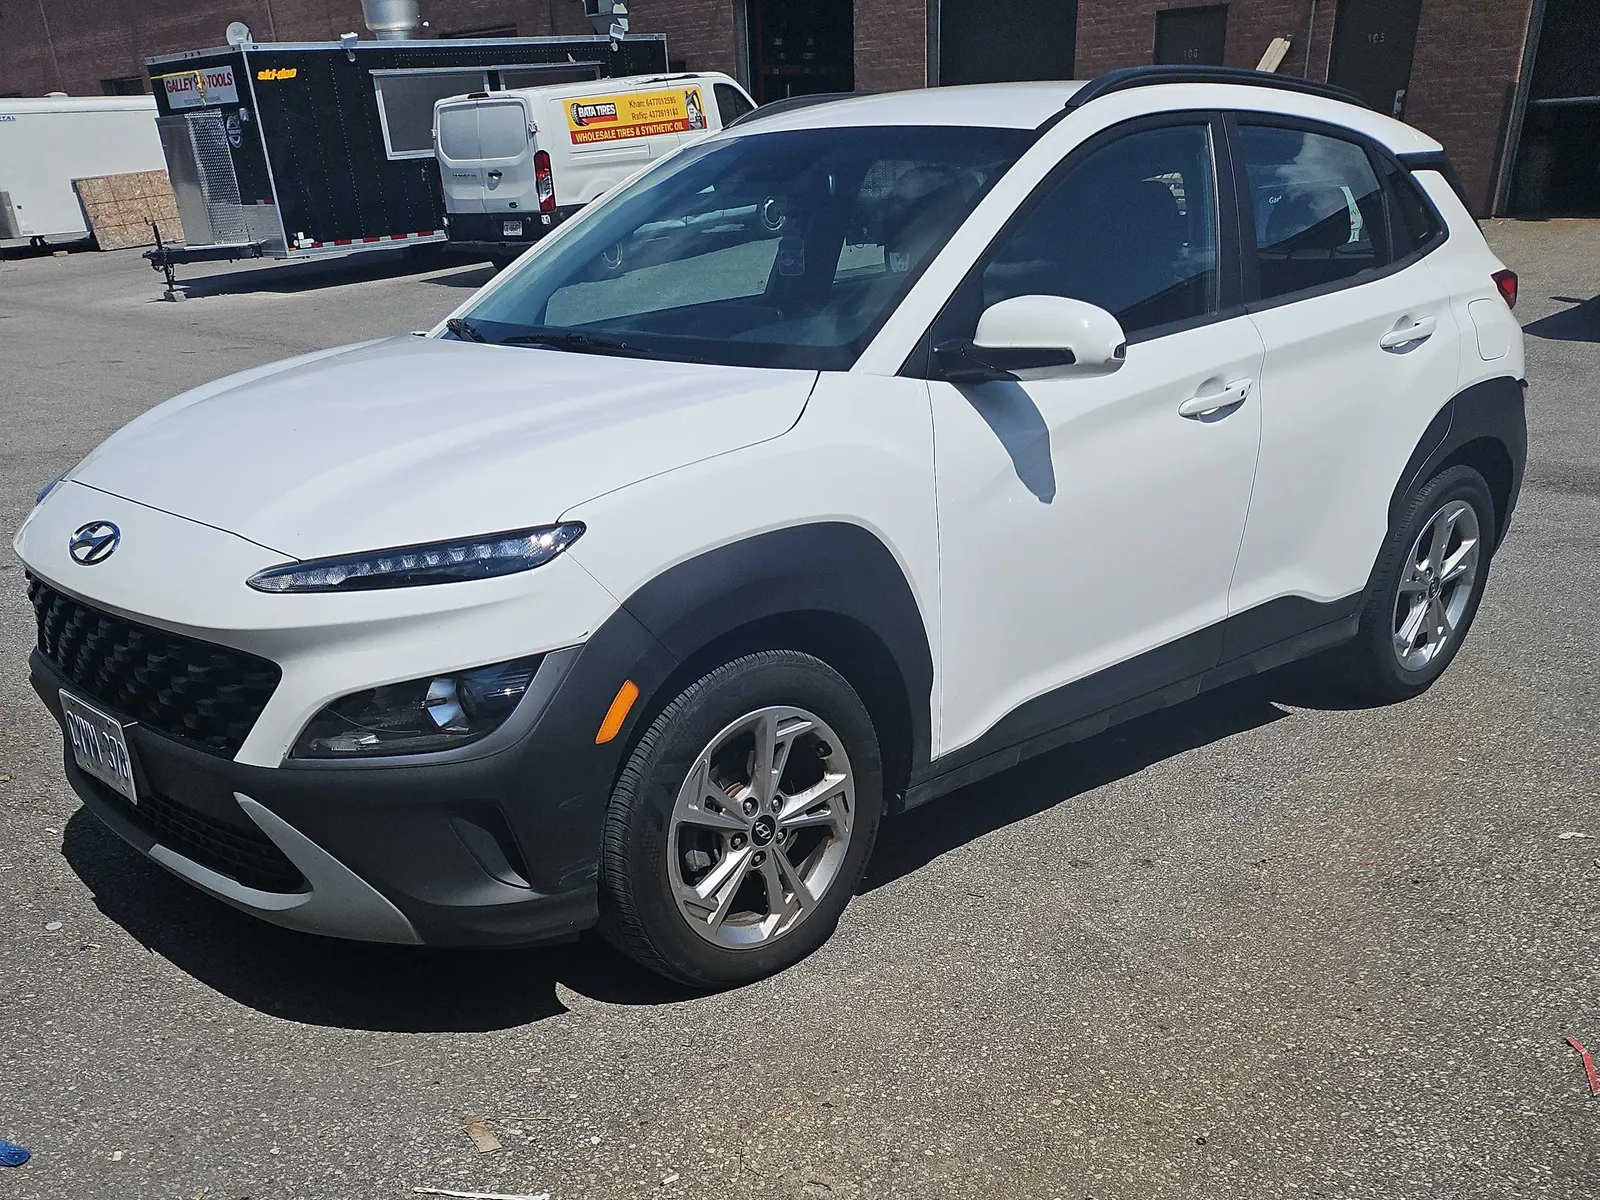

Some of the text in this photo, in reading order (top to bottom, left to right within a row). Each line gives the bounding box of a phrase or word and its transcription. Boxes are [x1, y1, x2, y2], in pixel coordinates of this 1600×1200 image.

[1367, 33, 1386, 43] 105
[166, 72, 233, 93] GALLEY TOOLS
[577, 103, 616, 118] BATA TIRES
[628, 100, 645, 109] Khan:
[631, 111, 648, 121] Rafiq:
[575, 121, 685, 143] WHOLESALE TIRES & SYNTHETIC OIL
